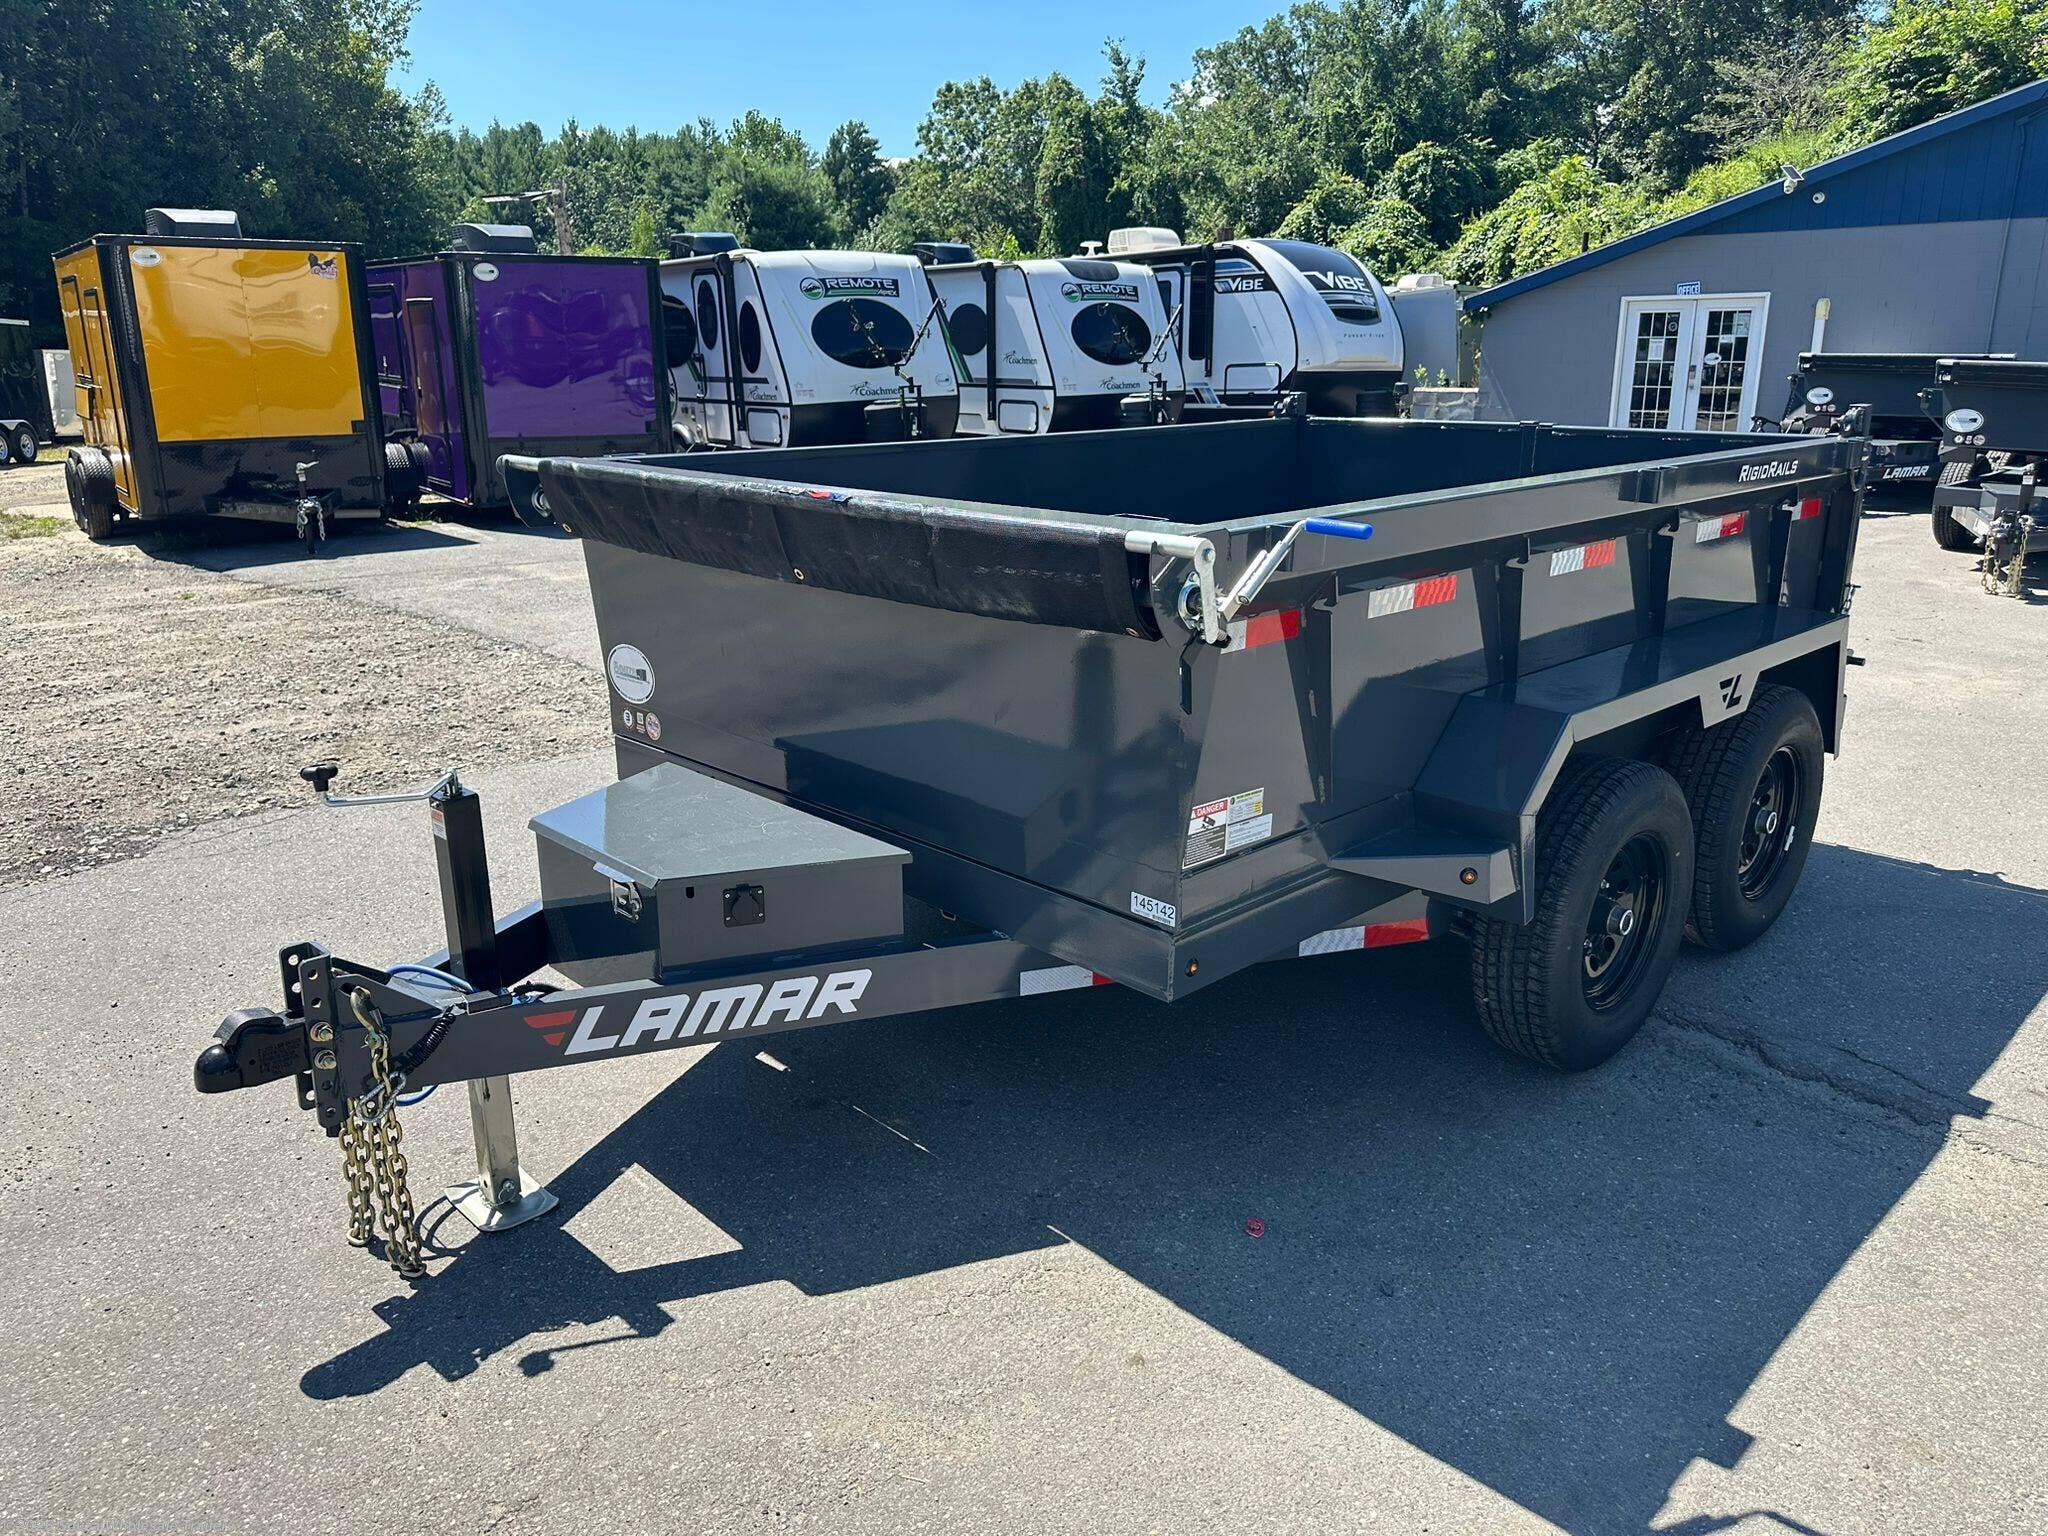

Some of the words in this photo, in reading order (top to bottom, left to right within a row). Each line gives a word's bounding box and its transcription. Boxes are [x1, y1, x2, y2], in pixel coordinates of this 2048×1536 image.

[825, 278, 895, 289] REMOTE
[1215, 277, 1264, 292] VIBE
[1302, 271, 1371, 292] VIBE
[1081, 284, 1136, 295] REMOTE
[1678, 284, 1699, 296] OFFICE
[1106, 380, 1141, 391] Coachmen
[1882, 465, 1930, 480] LAMAR
[1196, 801, 1225, 817] DANGER
[1133, 895, 1175, 920] 145142
[563, 967, 873, 1056] LAMAR
